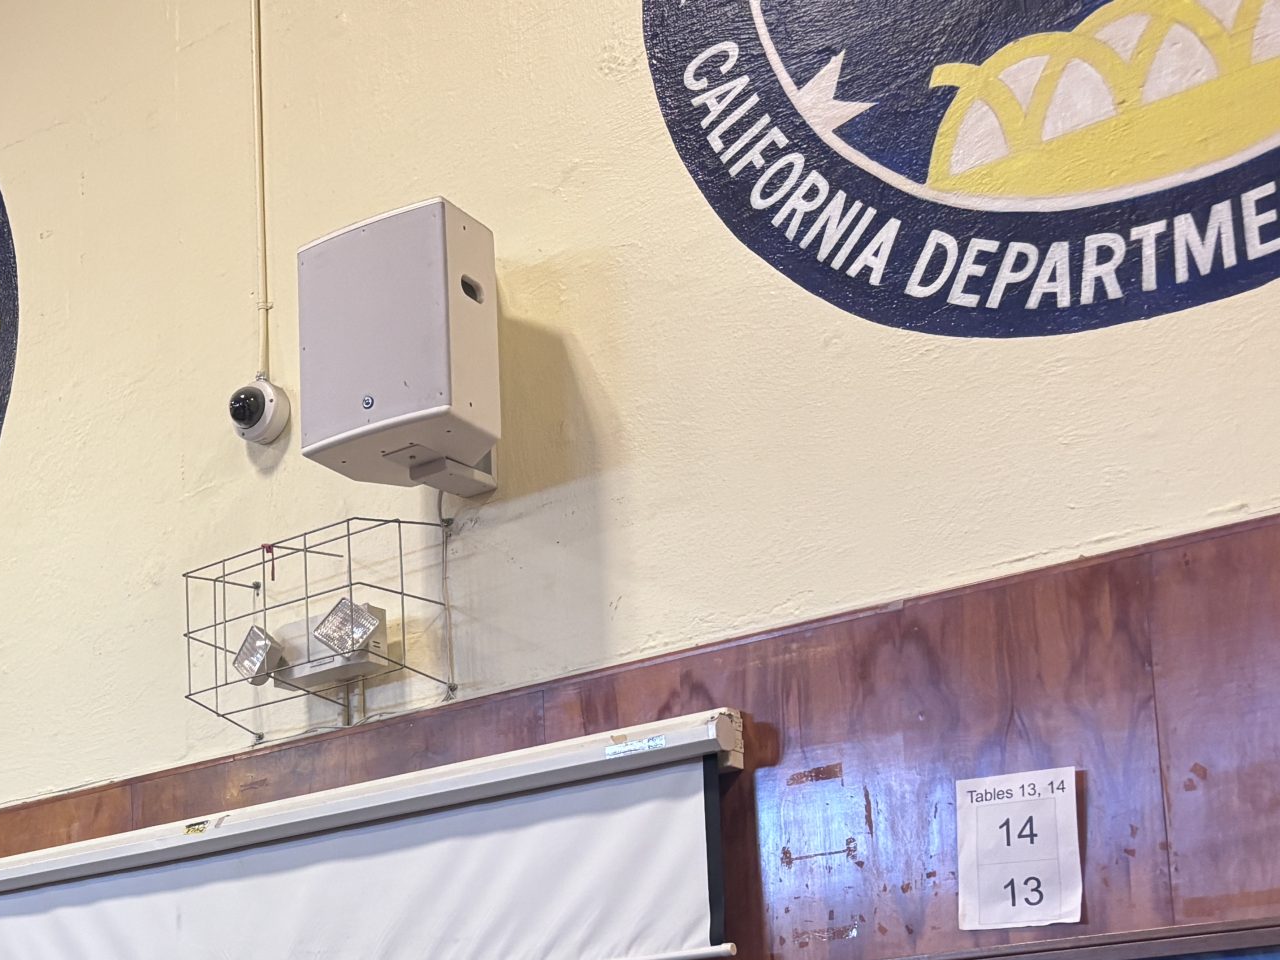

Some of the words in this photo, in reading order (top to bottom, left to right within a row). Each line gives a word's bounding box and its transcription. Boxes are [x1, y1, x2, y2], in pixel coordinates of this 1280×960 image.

[683, 41, 901, 286] CALIFORNIA
[967, 787, 1013, 803] Tables
[1019, 782, 1041, 797] 13,
[1047, 779, 1066, 794] 14
[998, 815, 1038, 847] 14
[1003, 876, 1044, 907] 13
